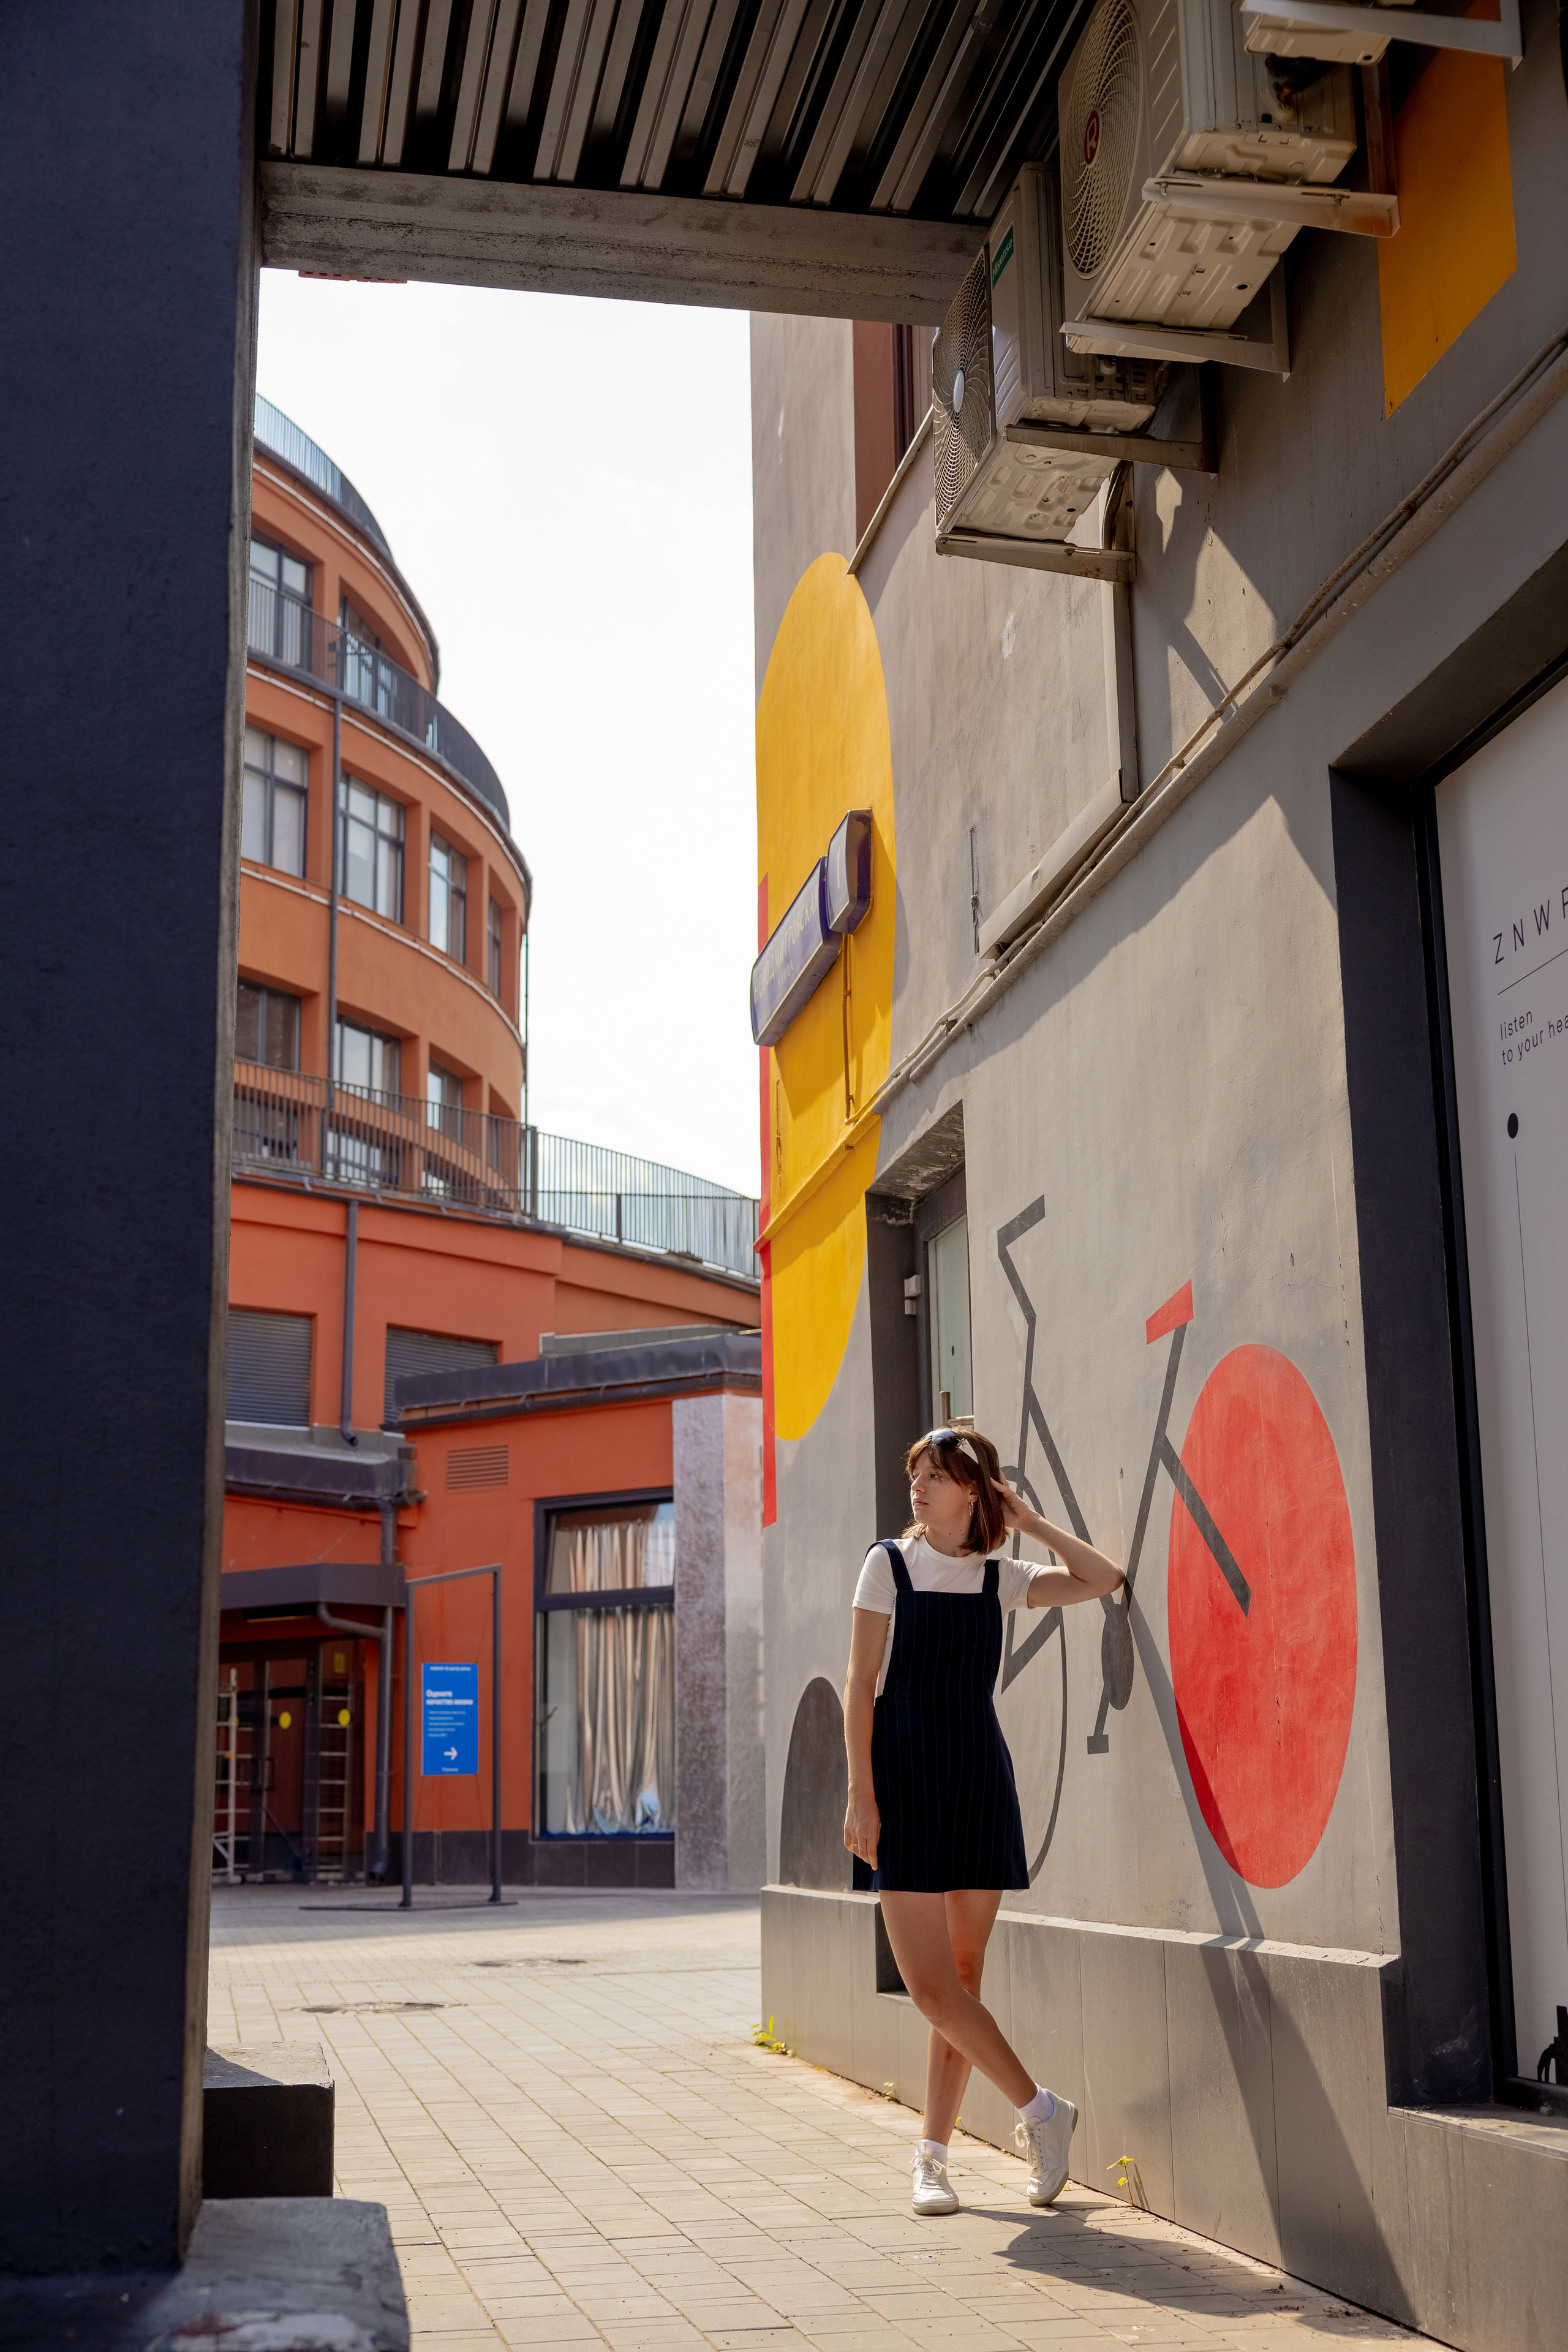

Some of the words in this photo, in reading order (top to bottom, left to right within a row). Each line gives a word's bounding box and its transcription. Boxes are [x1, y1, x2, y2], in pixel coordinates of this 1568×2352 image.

[992, 238, 1012, 281] Hisense
[835, 847, 841, 889] 1
[753, 884, 819, 1005] НОВОДМИТРОВСКАЯ
[1500, 1011, 1532, 1041] listen
[1502, 1049, 1513, 1065] to
[1517, 1030, 1544, 1061] your
